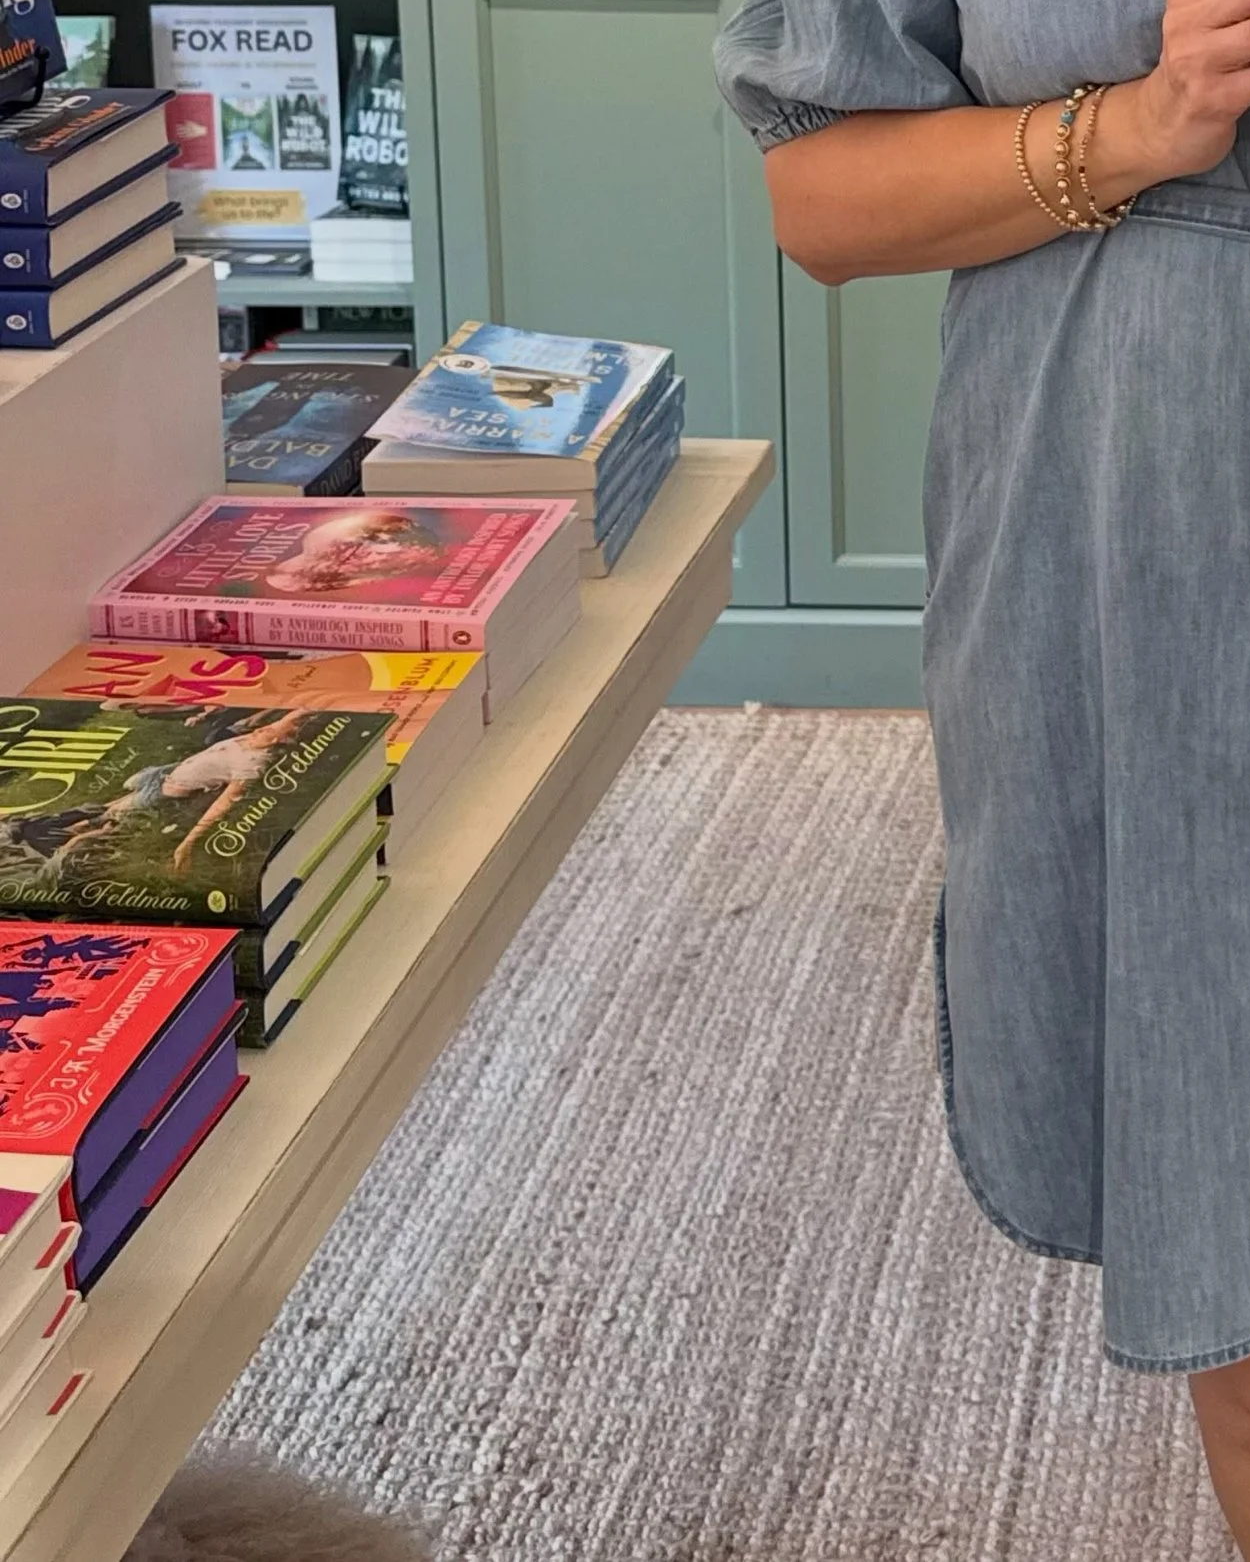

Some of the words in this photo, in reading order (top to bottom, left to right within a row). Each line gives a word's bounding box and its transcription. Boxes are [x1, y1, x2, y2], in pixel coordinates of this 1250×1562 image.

[171, 29, 227, 52] FOX
[236, 29, 313, 52] READ
[228, 512, 285, 544] LOVE
[222, 522, 312, 581] STORIES
[287, 618, 352, 634] ANTHOLOGY
[354, 621, 404, 635] INSPIRED
[287, 631, 327, 645] TAYLOR
[330, 633, 363, 646] SWIFT
[365, 634, 405, 648] SONGS
[205, 794, 279, 858] Sonia
[262, 712, 352, 795] Feldman
[0, 878, 73, 906] Sonia
[77, 879, 191, 912] Feldman
